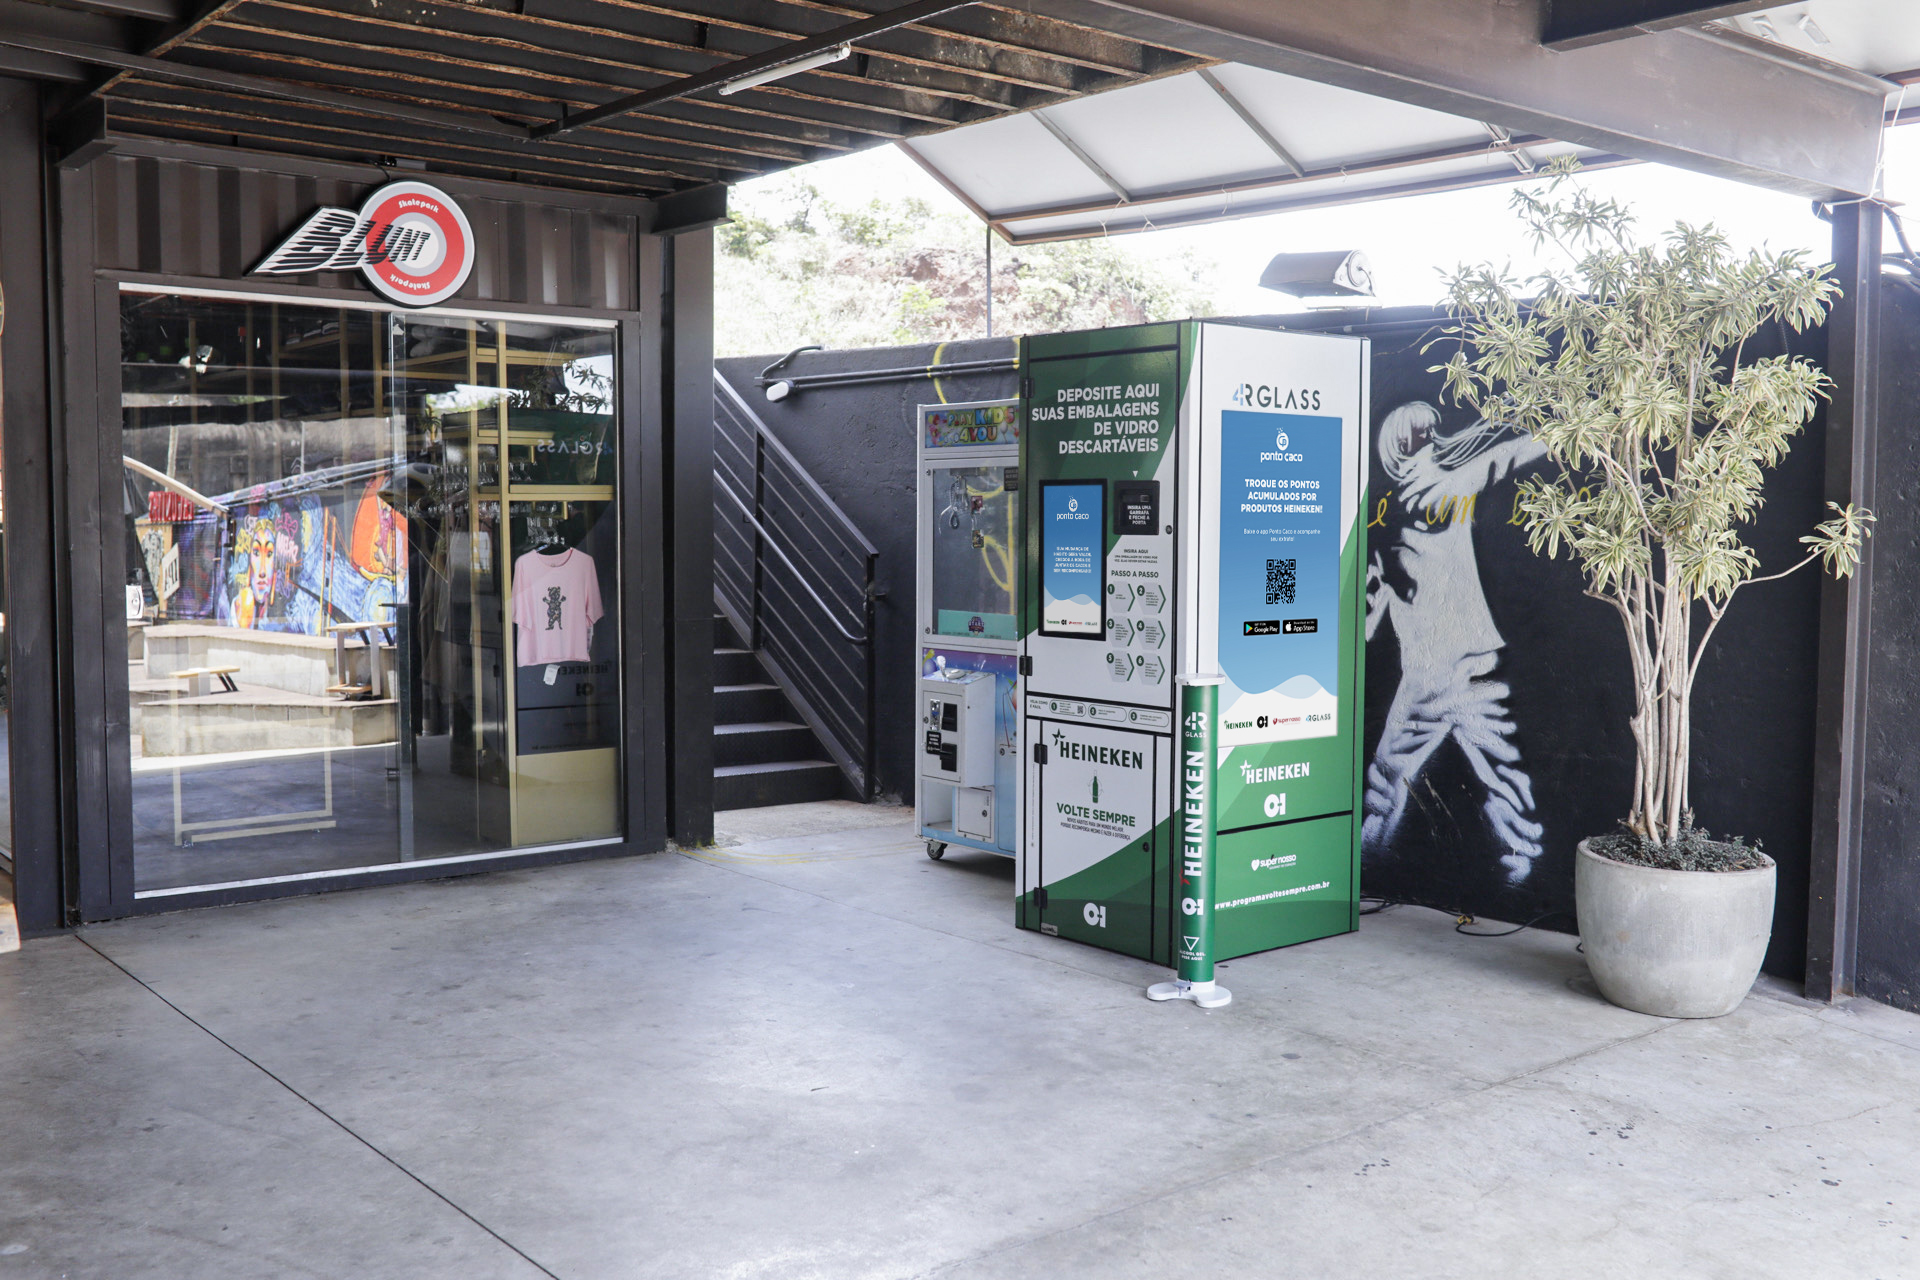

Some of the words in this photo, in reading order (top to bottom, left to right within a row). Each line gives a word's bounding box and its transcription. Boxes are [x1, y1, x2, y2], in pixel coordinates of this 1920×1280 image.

[398, 198, 439, 213] Skatepark
[258, 210, 431, 271] BLUNT
[390, 274, 430, 290] Skatepark
[1057, 385, 1122, 402] DEPOSITE
[1124, 383, 1160, 399] AQUI
[948, 412, 974, 426] PLAY
[974, 406, 1015, 426] KIDS
[1032, 406, 1064, 421] SUAS
[1068, 402, 1160, 419] EMBALAGENS
[1094, 422, 1112, 436] DE
[1115, 420, 1159, 434] VIDRO
[1059, 435, 1158, 454] DESCARTÁVEIS
[1260, 451, 1283, 463] ponto
[1284, 453, 1303, 462] caco
[1245, 479, 1276, 488] TROQUE
[1278, 480, 1288, 488] OS
[1290, 480, 1320, 489] PONTOS
[1248, 491, 1300, 501] ACUMULADOS
[1301, 493, 1317, 501] POR
[1056, 512, 1074, 521] ponto
[1241, 504, 1282, 513] PRODUTOS
[1284, 505, 1323, 513] HEINEKEN!
[1060, 741, 1143, 770] HEINEKEN
[1246, 762, 1310, 784] HEINEKEN
[1057, 802, 1090, 818] VOLTE
[1093, 809, 1135, 827] SEMPRE
[1184, 750, 1204, 876] HEINEKEN
[1260, 857, 1278, 868] super
[1277, 854, 1296, 864] nosso
[1215, 880, 1330, 910] www.programavoltesempre.com.br
